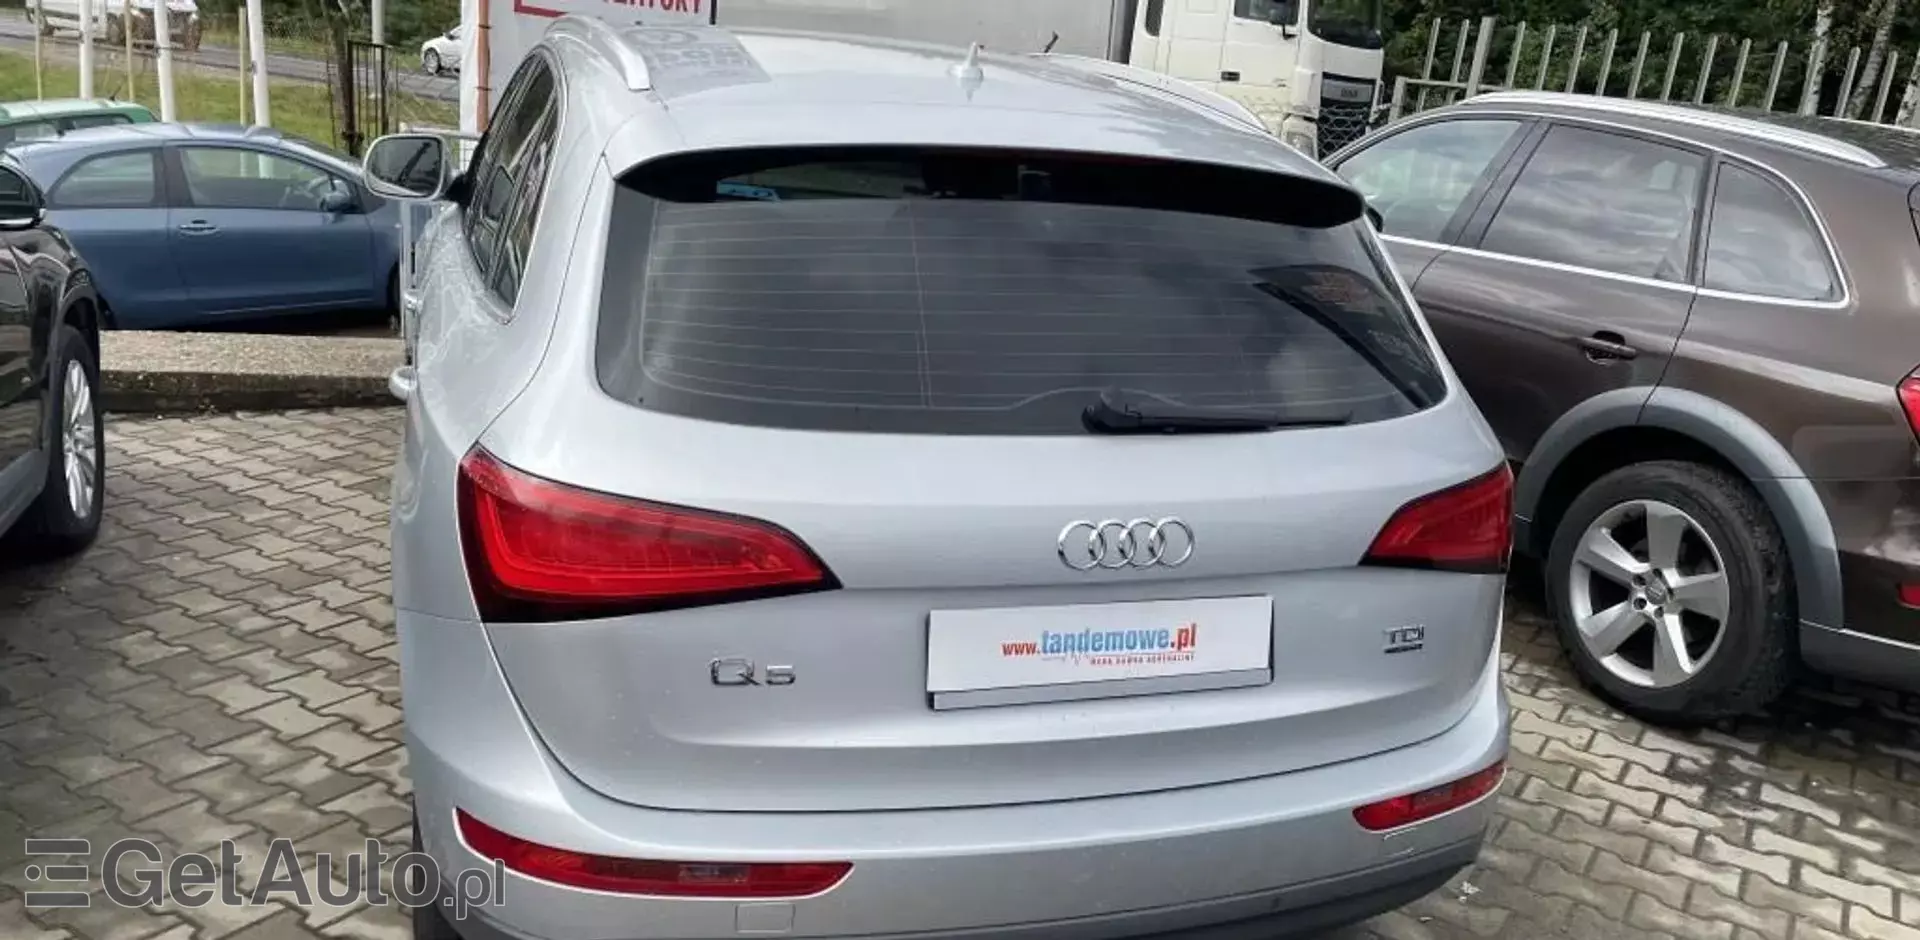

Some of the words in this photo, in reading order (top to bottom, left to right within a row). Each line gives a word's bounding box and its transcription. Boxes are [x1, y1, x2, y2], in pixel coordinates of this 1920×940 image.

[1001, 622, 1197, 657] www.tandemowe.pl
[1383, 626, 1425, 645] TDI
[709, 658, 796, 686] Q5
